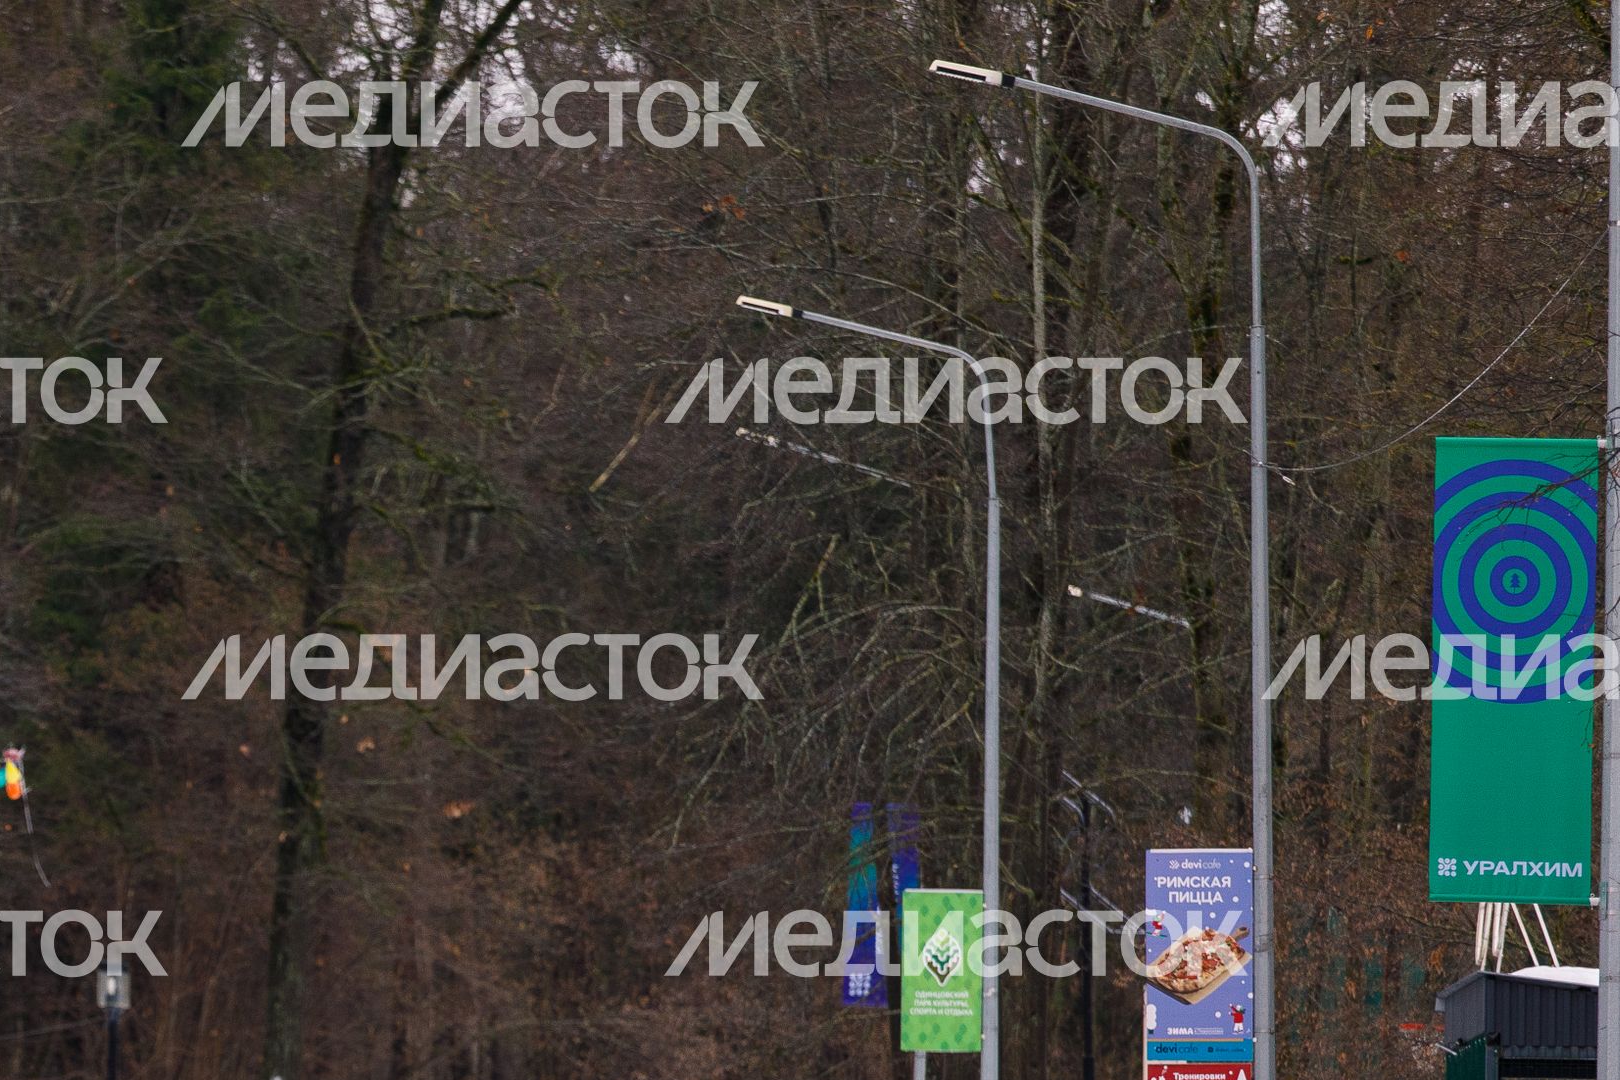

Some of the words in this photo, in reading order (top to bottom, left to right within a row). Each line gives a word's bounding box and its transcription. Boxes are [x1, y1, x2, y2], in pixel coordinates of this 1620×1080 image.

[1462, 860, 1583, 878] УРАЛХИМ
[1157, 876, 1232, 888] РИМСКАЯ
[1168, 891, 1224, 905] ПИЦЦА
[1167, 1027, 1194, 1035] ЗИМА
